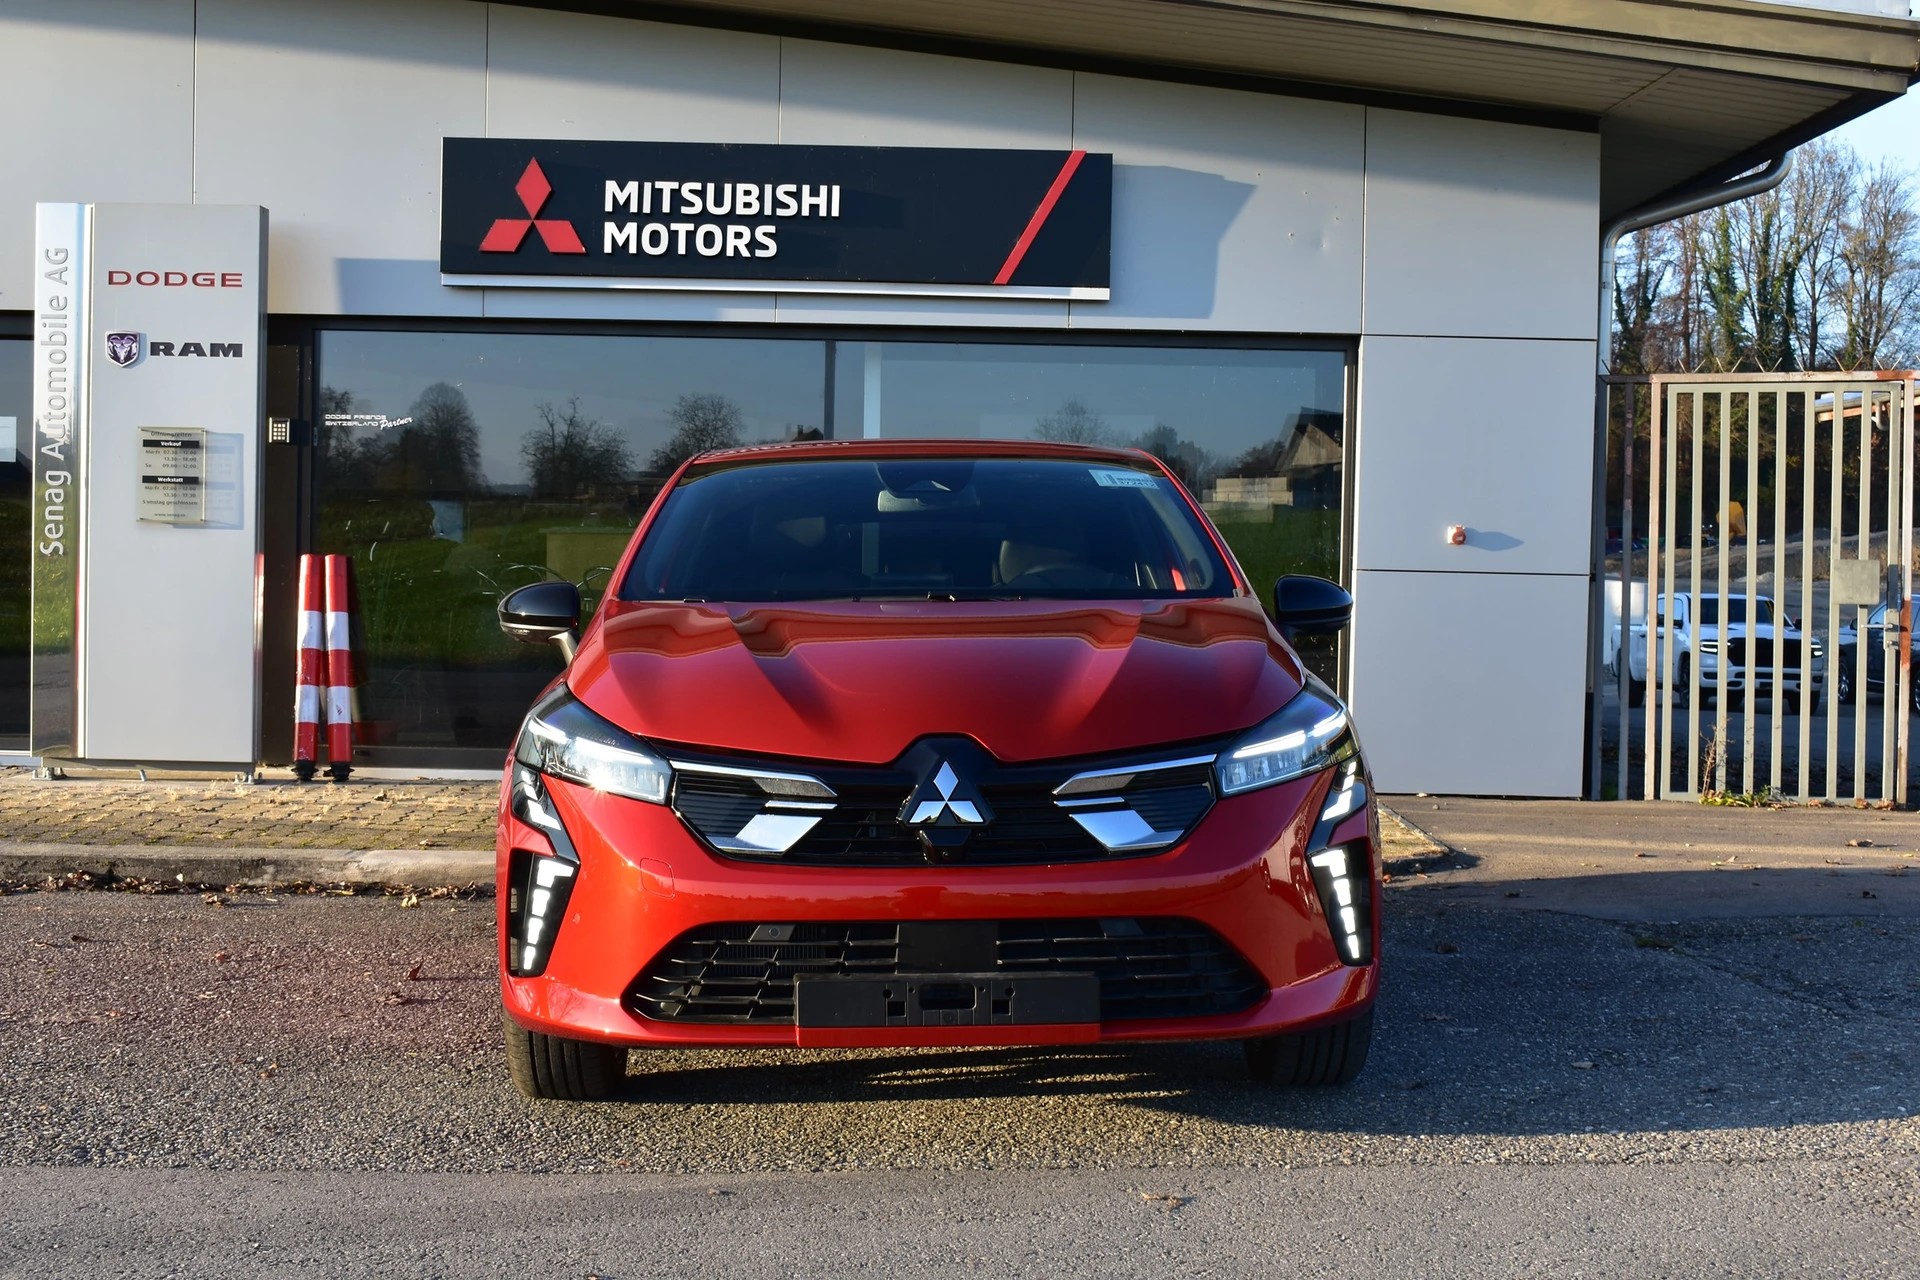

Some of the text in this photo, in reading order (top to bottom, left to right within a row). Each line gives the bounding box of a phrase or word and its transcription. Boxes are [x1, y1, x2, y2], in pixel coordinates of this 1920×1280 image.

[604, 180, 840, 217] MITSUBISHI
[603, 222, 778, 258] MOTORS
[108, 271, 242, 287] DODGE
[150, 342, 243, 358] RAM
[40, 248, 71, 556] Senag Automobile AG
[380, 417, 413, 430] Partner
